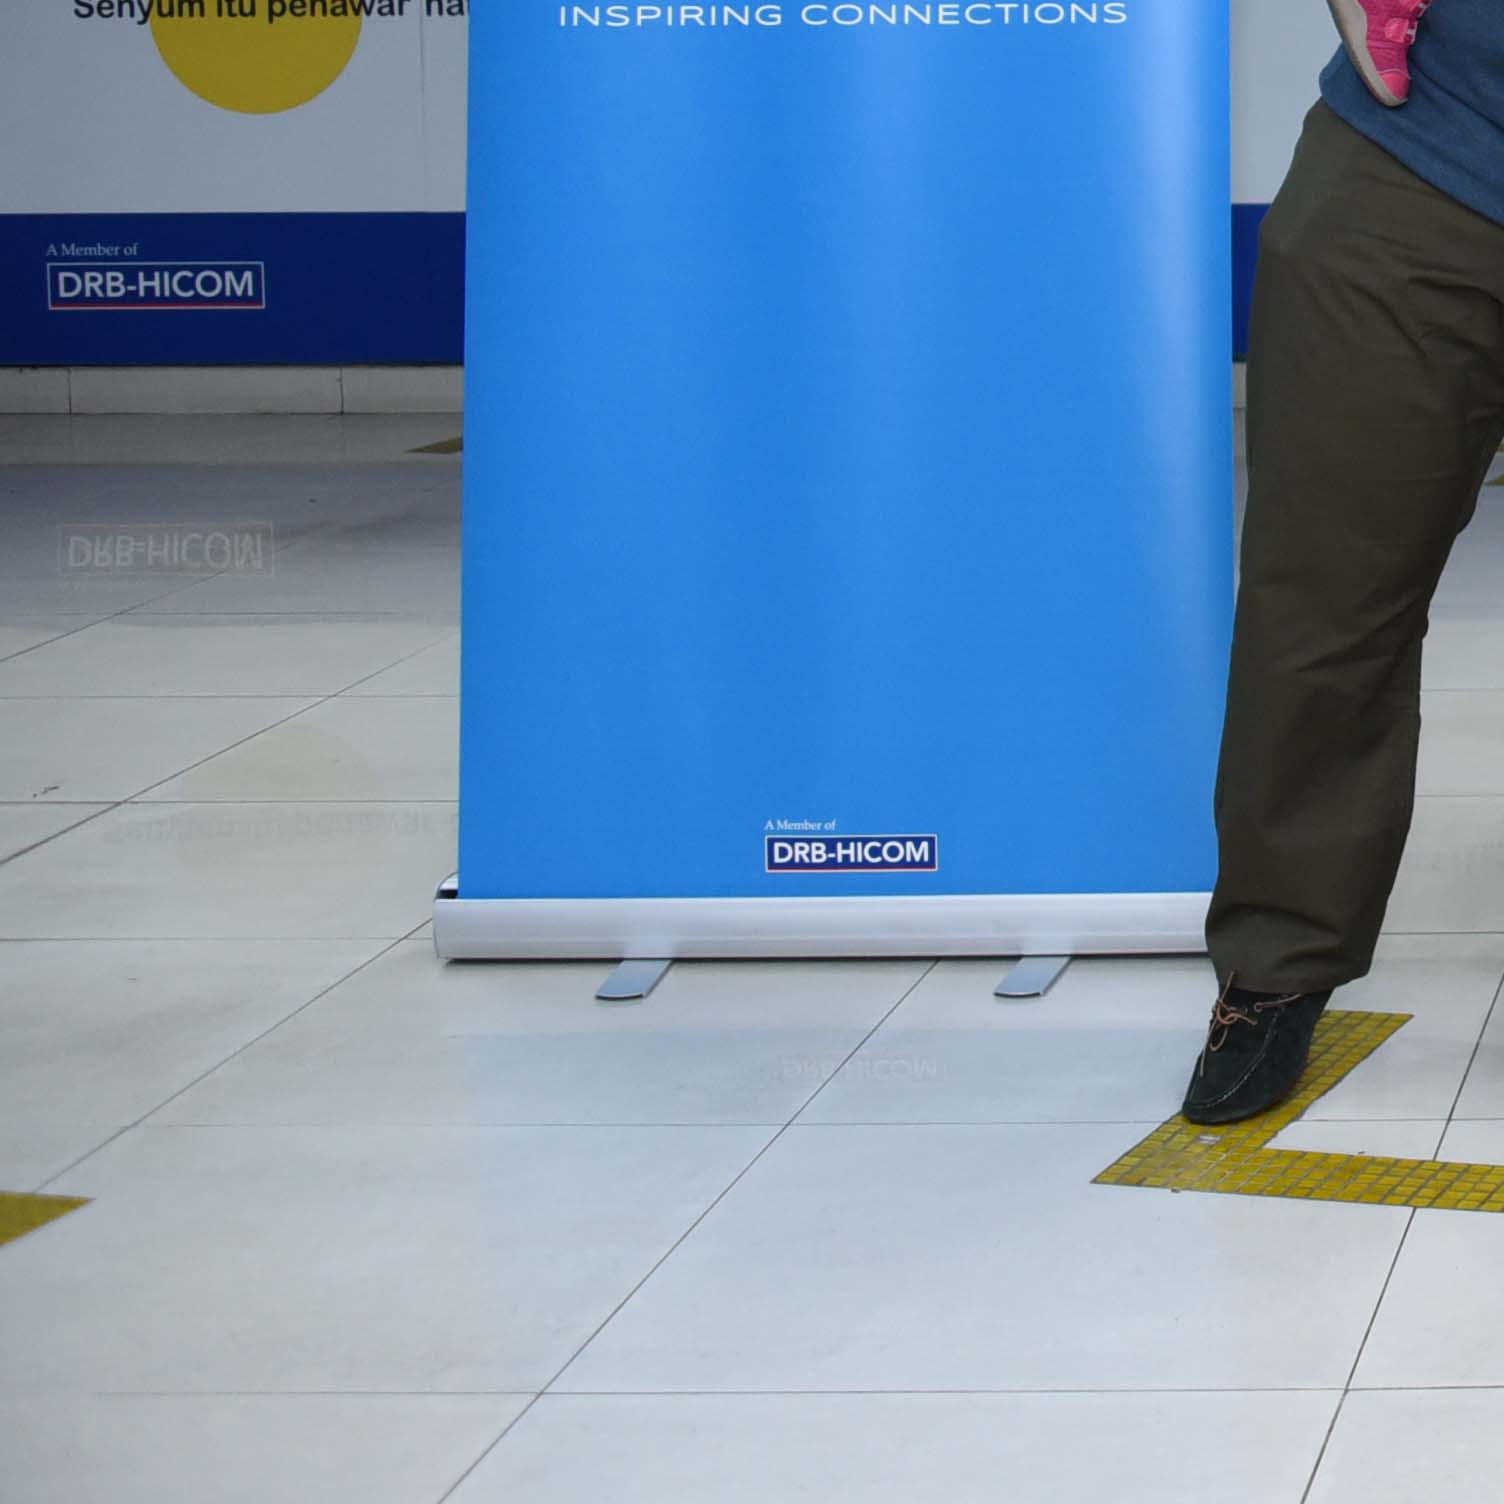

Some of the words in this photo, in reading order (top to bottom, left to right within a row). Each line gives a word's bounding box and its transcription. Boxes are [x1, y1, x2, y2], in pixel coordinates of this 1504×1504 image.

[560, 3, 782, 28] INSPIRING
[801, 0, 1127, 26] CONNECTIONS
[46, 244, 58, 257] A
[61, 243, 120, 257] Member
[123, 242, 139, 256] of
[57, 269, 255, 298] DRB-HICOM
[763, 819, 774, 831] A
[777, 819, 822, 831] Member
[824, 818, 837, 831] of
[773, 840, 930, 864] DRB-HICOM
